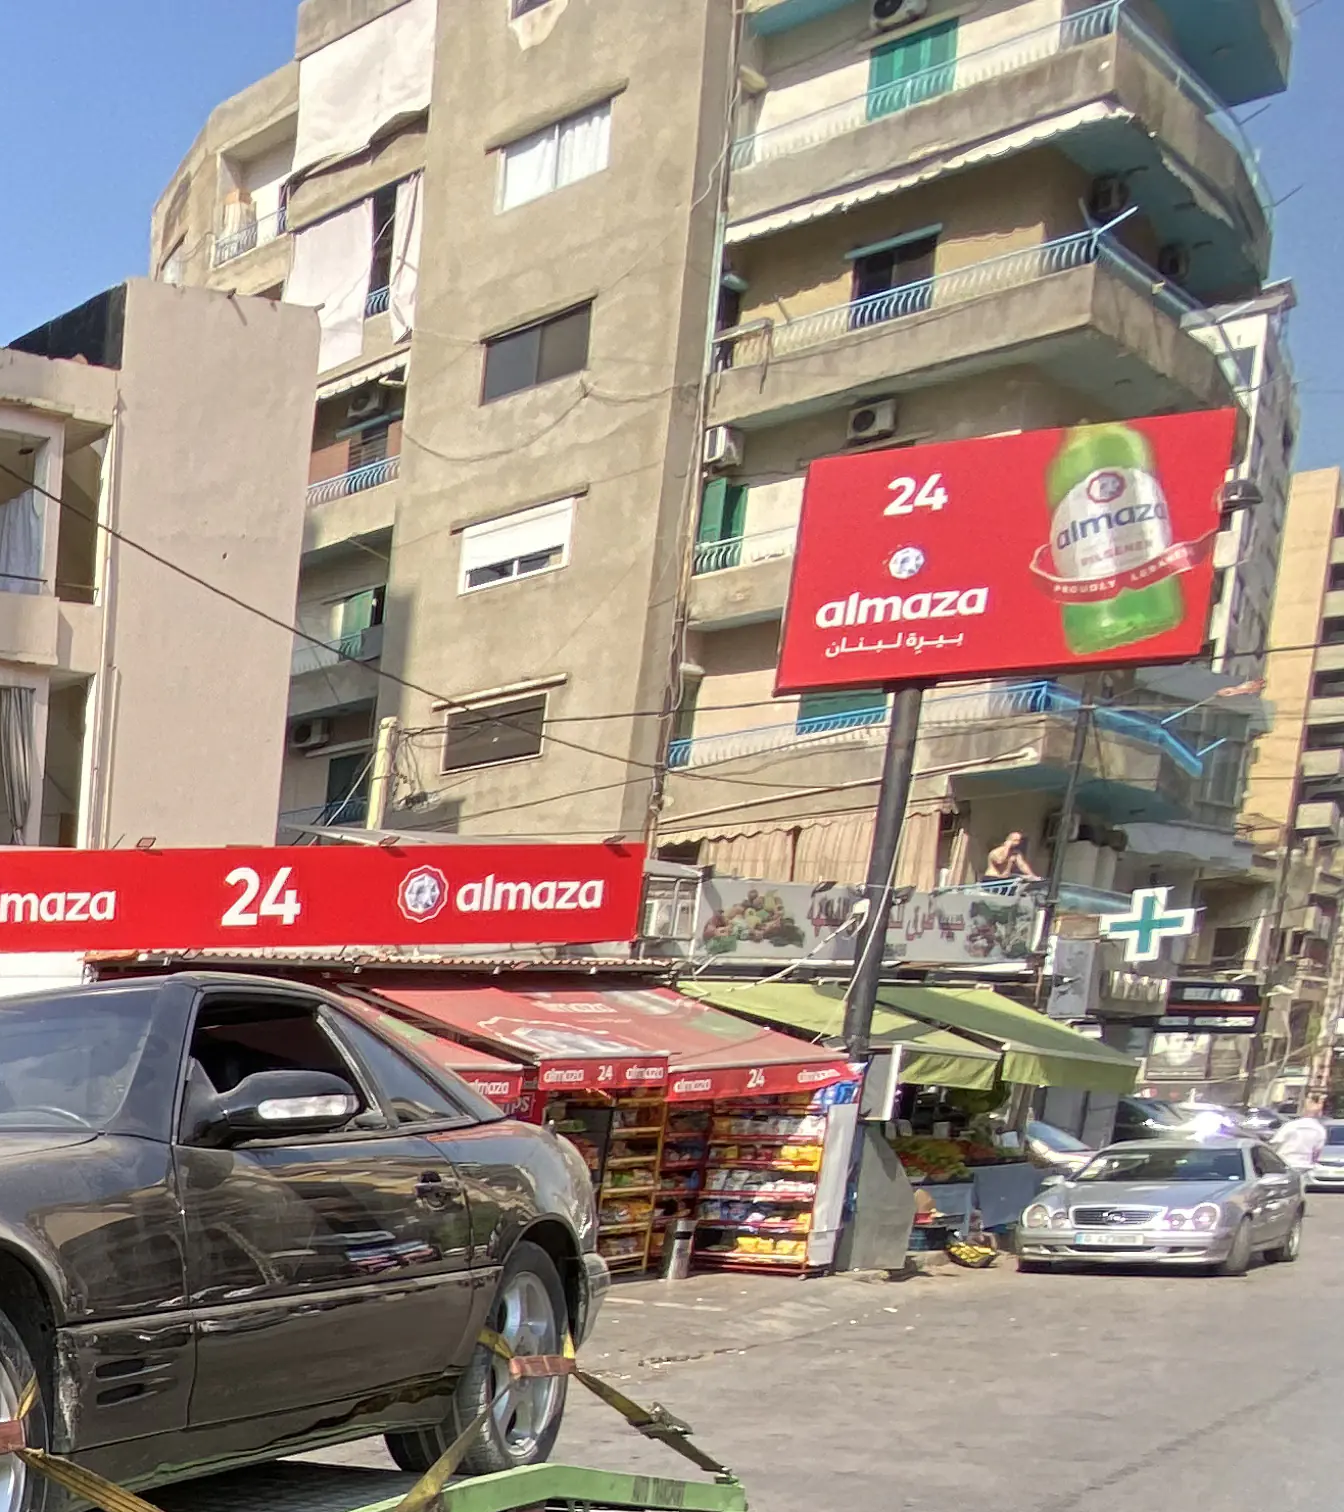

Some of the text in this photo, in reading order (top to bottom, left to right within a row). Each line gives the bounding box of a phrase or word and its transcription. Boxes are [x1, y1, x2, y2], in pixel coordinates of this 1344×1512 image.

[883, 473, 949, 516] 24
[1054, 580, 1116, 594] PROUDLY
[815, 587, 989, 628] almaza
[825, 632, 964, 658] بيرة لبنان
[220, 867, 302, 926] 24
[455, 873, 605, 914] almaza
[598, 1065, 614, 1081] 24
[746, 1069, 765, 1088] 24
